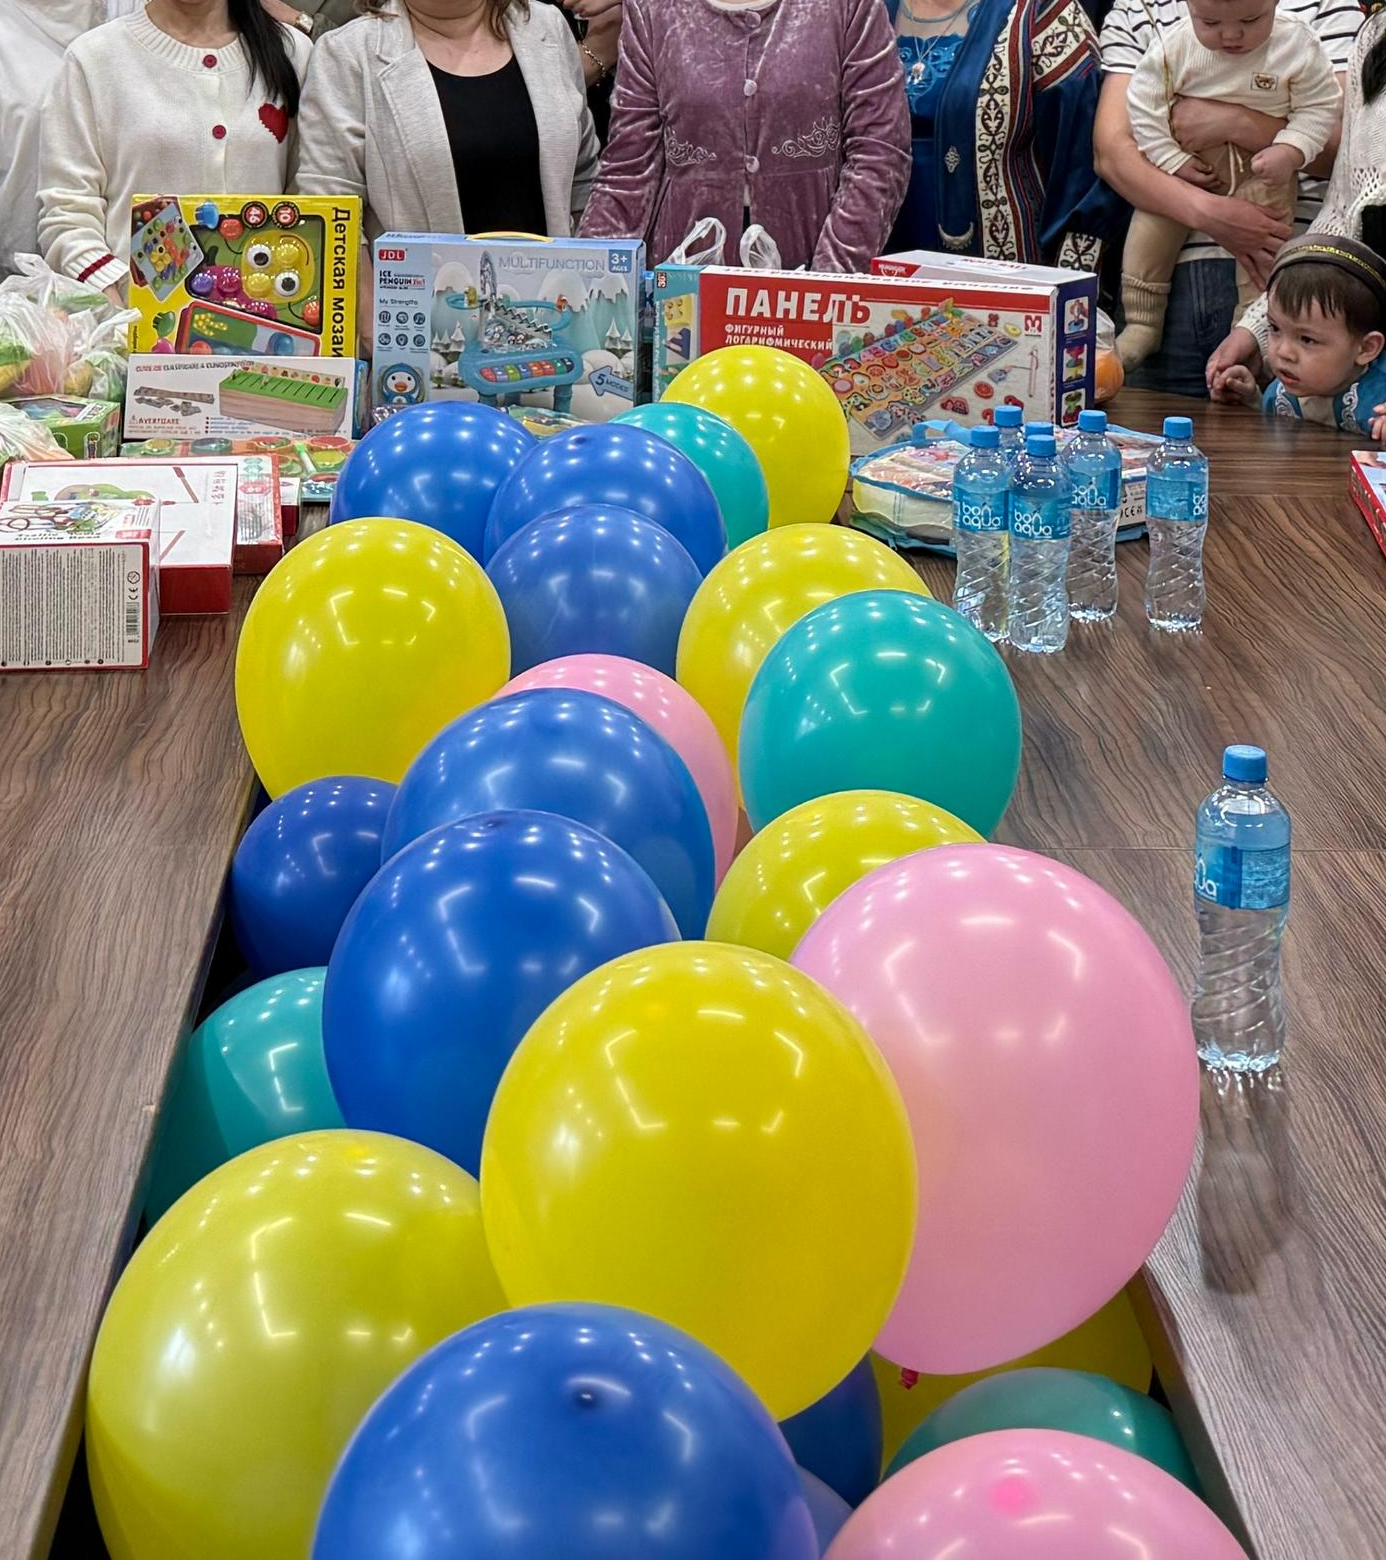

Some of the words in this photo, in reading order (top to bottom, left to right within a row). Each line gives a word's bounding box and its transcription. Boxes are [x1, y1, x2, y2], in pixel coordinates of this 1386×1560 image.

[248, 208, 262, 222] 46
[282, 209, 295, 222] 10
[332, 206, 351, 290] Детская
[380, 250, 403, 260] JDL
[498, 255, 605, 271] MULTIFUNCTION
[611, 253, 628, 265] 3+
[379, 269, 392, 278] ICE
[379, 277, 412, 285] PENGUIN
[724, 287, 871, 325] ПАНЕЛЬ
[332, 297, 345, 358] мозаи
[724, 323, 785, 337] ФИГУРНЫЙ
[724, 334, 834, 351] ЛОГАРИФМИЧЕСКИЙ
[595, 373, 606, 386] 5
[962, 514, 1002, 531] aqua
[1014, 520, 1053, 536] aqua
